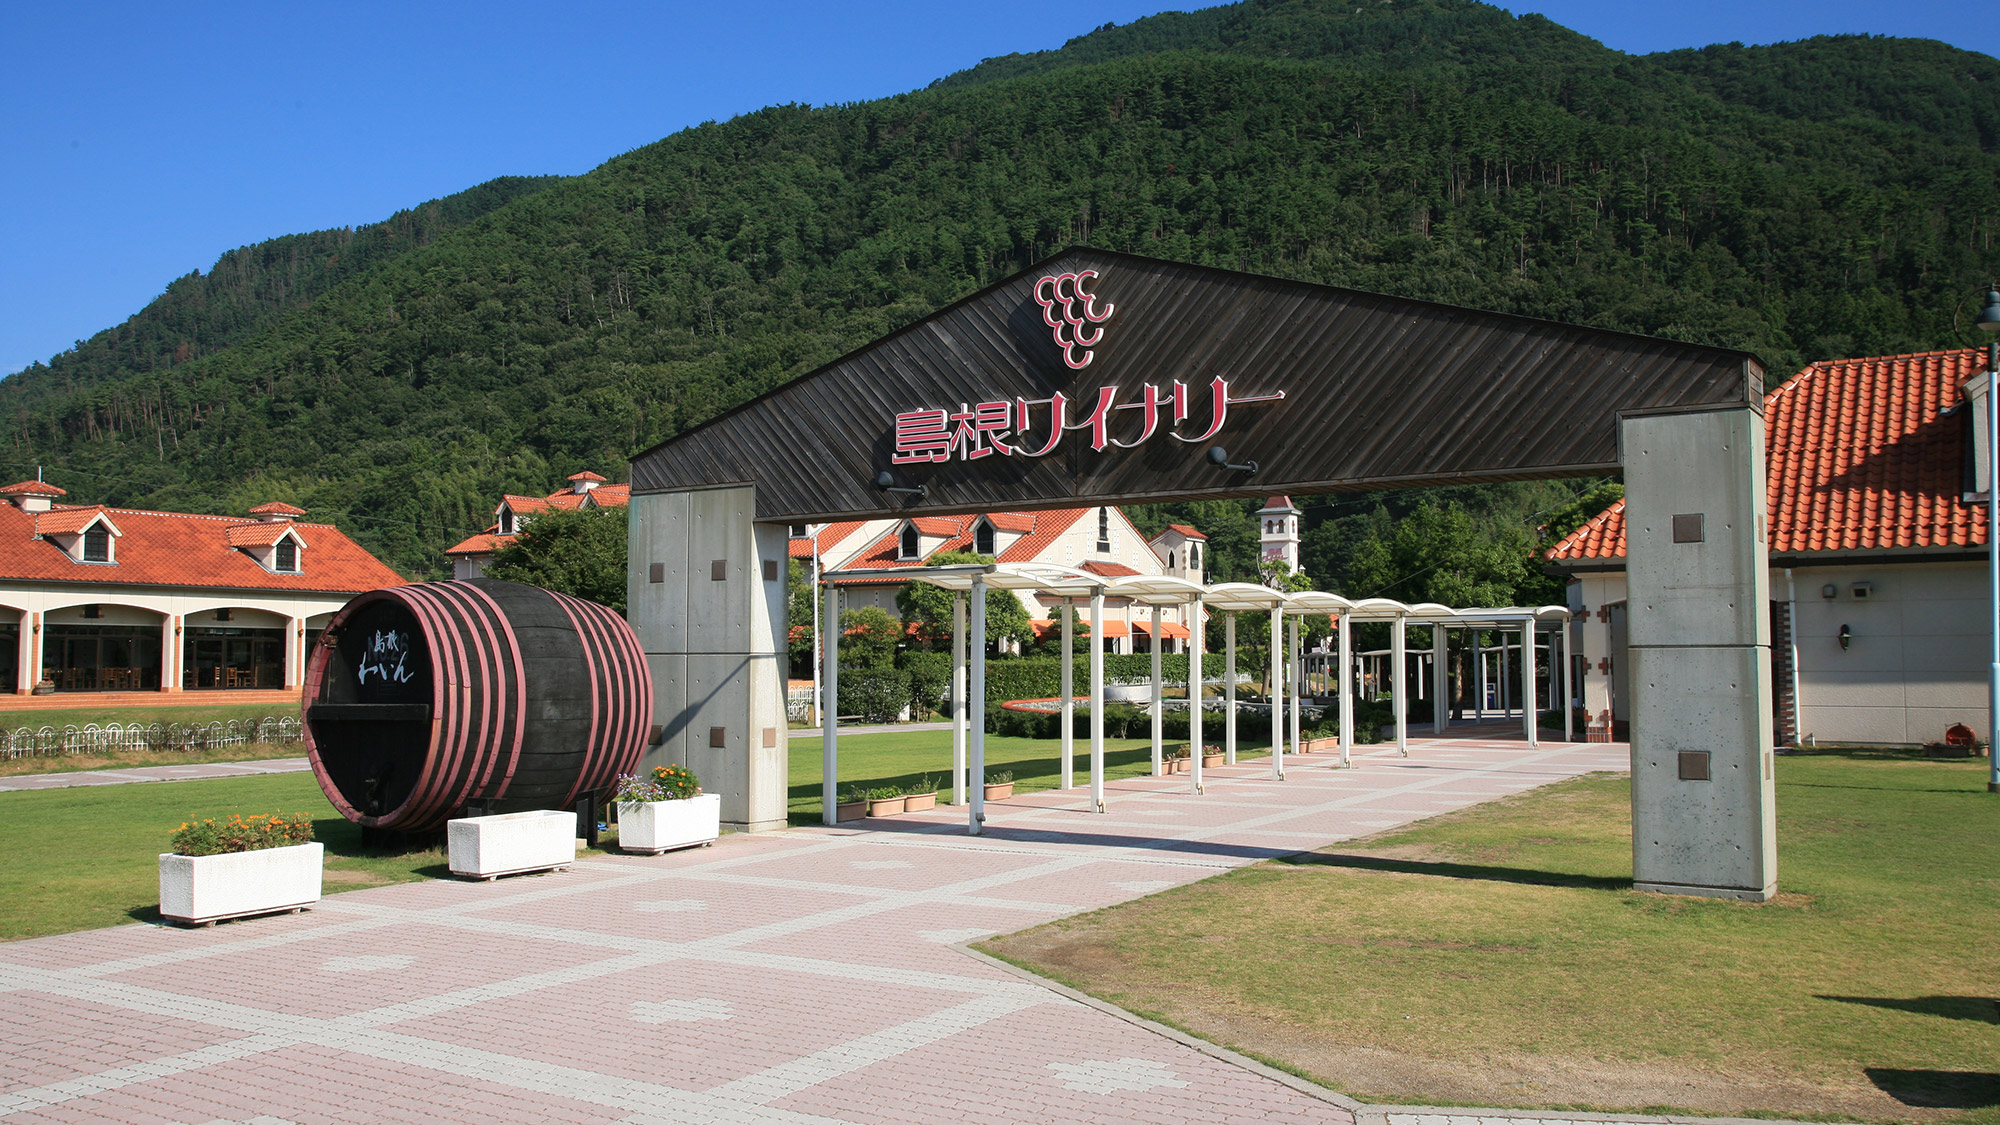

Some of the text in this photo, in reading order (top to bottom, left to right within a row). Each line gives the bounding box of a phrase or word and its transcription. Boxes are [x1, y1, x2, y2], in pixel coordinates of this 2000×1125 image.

[891, 375, 1287, 465] 島根ワイナリー
[358, 651, 414, 685] わいん
